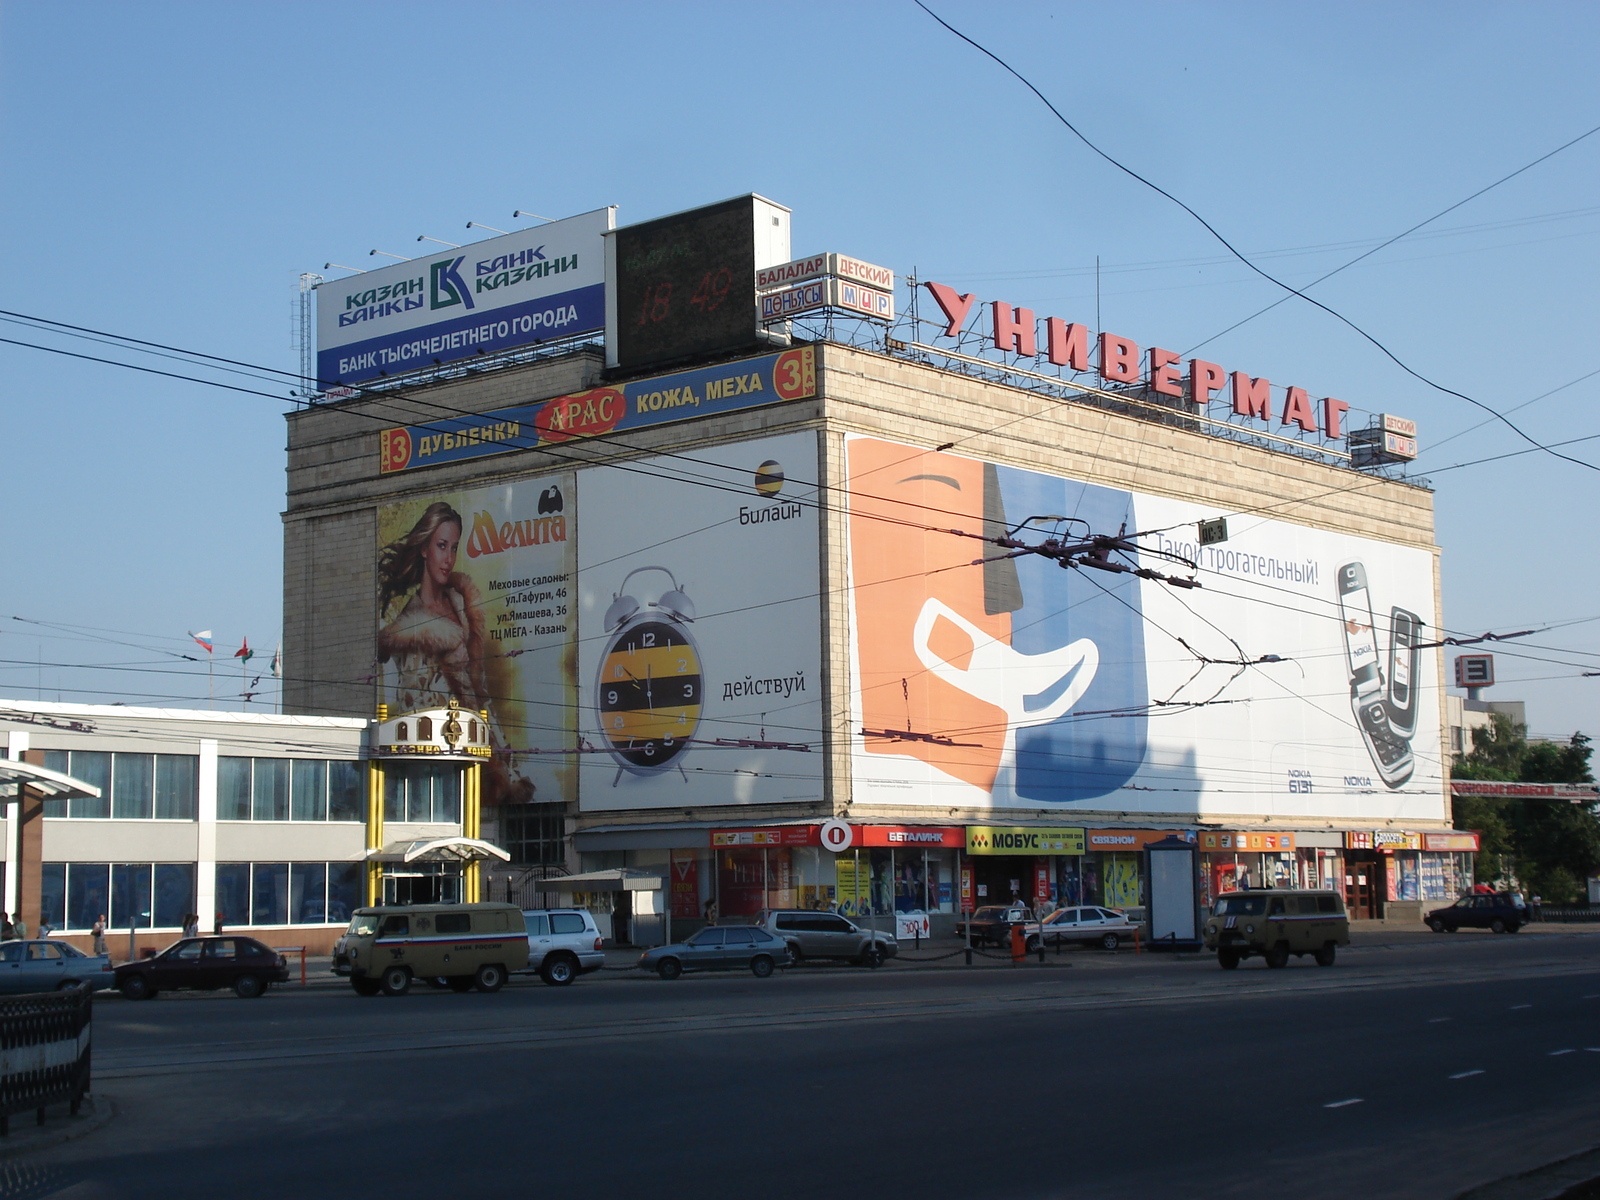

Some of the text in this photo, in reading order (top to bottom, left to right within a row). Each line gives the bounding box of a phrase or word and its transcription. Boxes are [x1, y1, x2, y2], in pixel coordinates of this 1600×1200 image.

[476, 245, 546, 276] БАНК
[476, 254, 578, 294] КАЗАНИ
[759, 257, 824, 286] БАЛАЛАР
[840, 258, 890, 286] ДЕТСКИЙ
[346, 276, 424, 310] КАЗАН
[637, 267, 732, 326] 18 49
[339, 294, 424, 328] БАНКЫ
[339, 304, 578, 375] БАНК ТЫСЯЧЕЛЕТНЕГО ГОРОДА
[925, 281, 1349, 439] УНИВЕРМАГ
[782, 359, 801, 391] 3
[805, 350, 815, 395] ЭТАЖ
[637, 373, 763, 414] КОЖА, МЕХА
[547, 395, 614, 432] АРАС
[1386, 417, 1415, 433] ДЕТСКИЙ
[418, 420, 520, 458] ДУБЛЕНКИ
[381, 434, 389, 472] ЭТАЖ
[392, 435, 407, 463] 3
[739, 500, 801, 525] Билайн
[467, 509, 567, 559] Мелита
[1155, 532, 1319, 586] Такой трогательный!
[489, 573, 569, 591] Меховые салоны:
[505, 589, 567, 607] ул.Гафури, 46
[497, 606, 567, 625] ул.Ямашева, 36
[490, 629, 502, 641] ТЦ
[504, 627, 527, 639] МЕГА
[534, 624, 567, 636] Казань
[642, 632, 656, 648] 12
[627, 642, 635, 655] 11
[1353, 644, 1372, 658] NOKIA
[613, 664, 624, 678] 10
[677, 659, 687, 672] 2
[683, 685, 693, 698] 3
[723, 671, 806, 701] действуй
[607, 691, 618, 704] 9
[613, 715, 625, 730] 8
[677, 712, 686, 726] 4
[663, 733, 674, 747] 5
[1287, 769, 1311, 779] NOKIA
[1343, 776, 1372, 787] NOKIA
[1289, 780, 1313, 794] 6131
[889, 832, 944, 842] БЕТАЛИНК
[992, 833, 1039, 849] МОБУС
[1091, 834, 1136, 845] СВЯЗНОЙ
